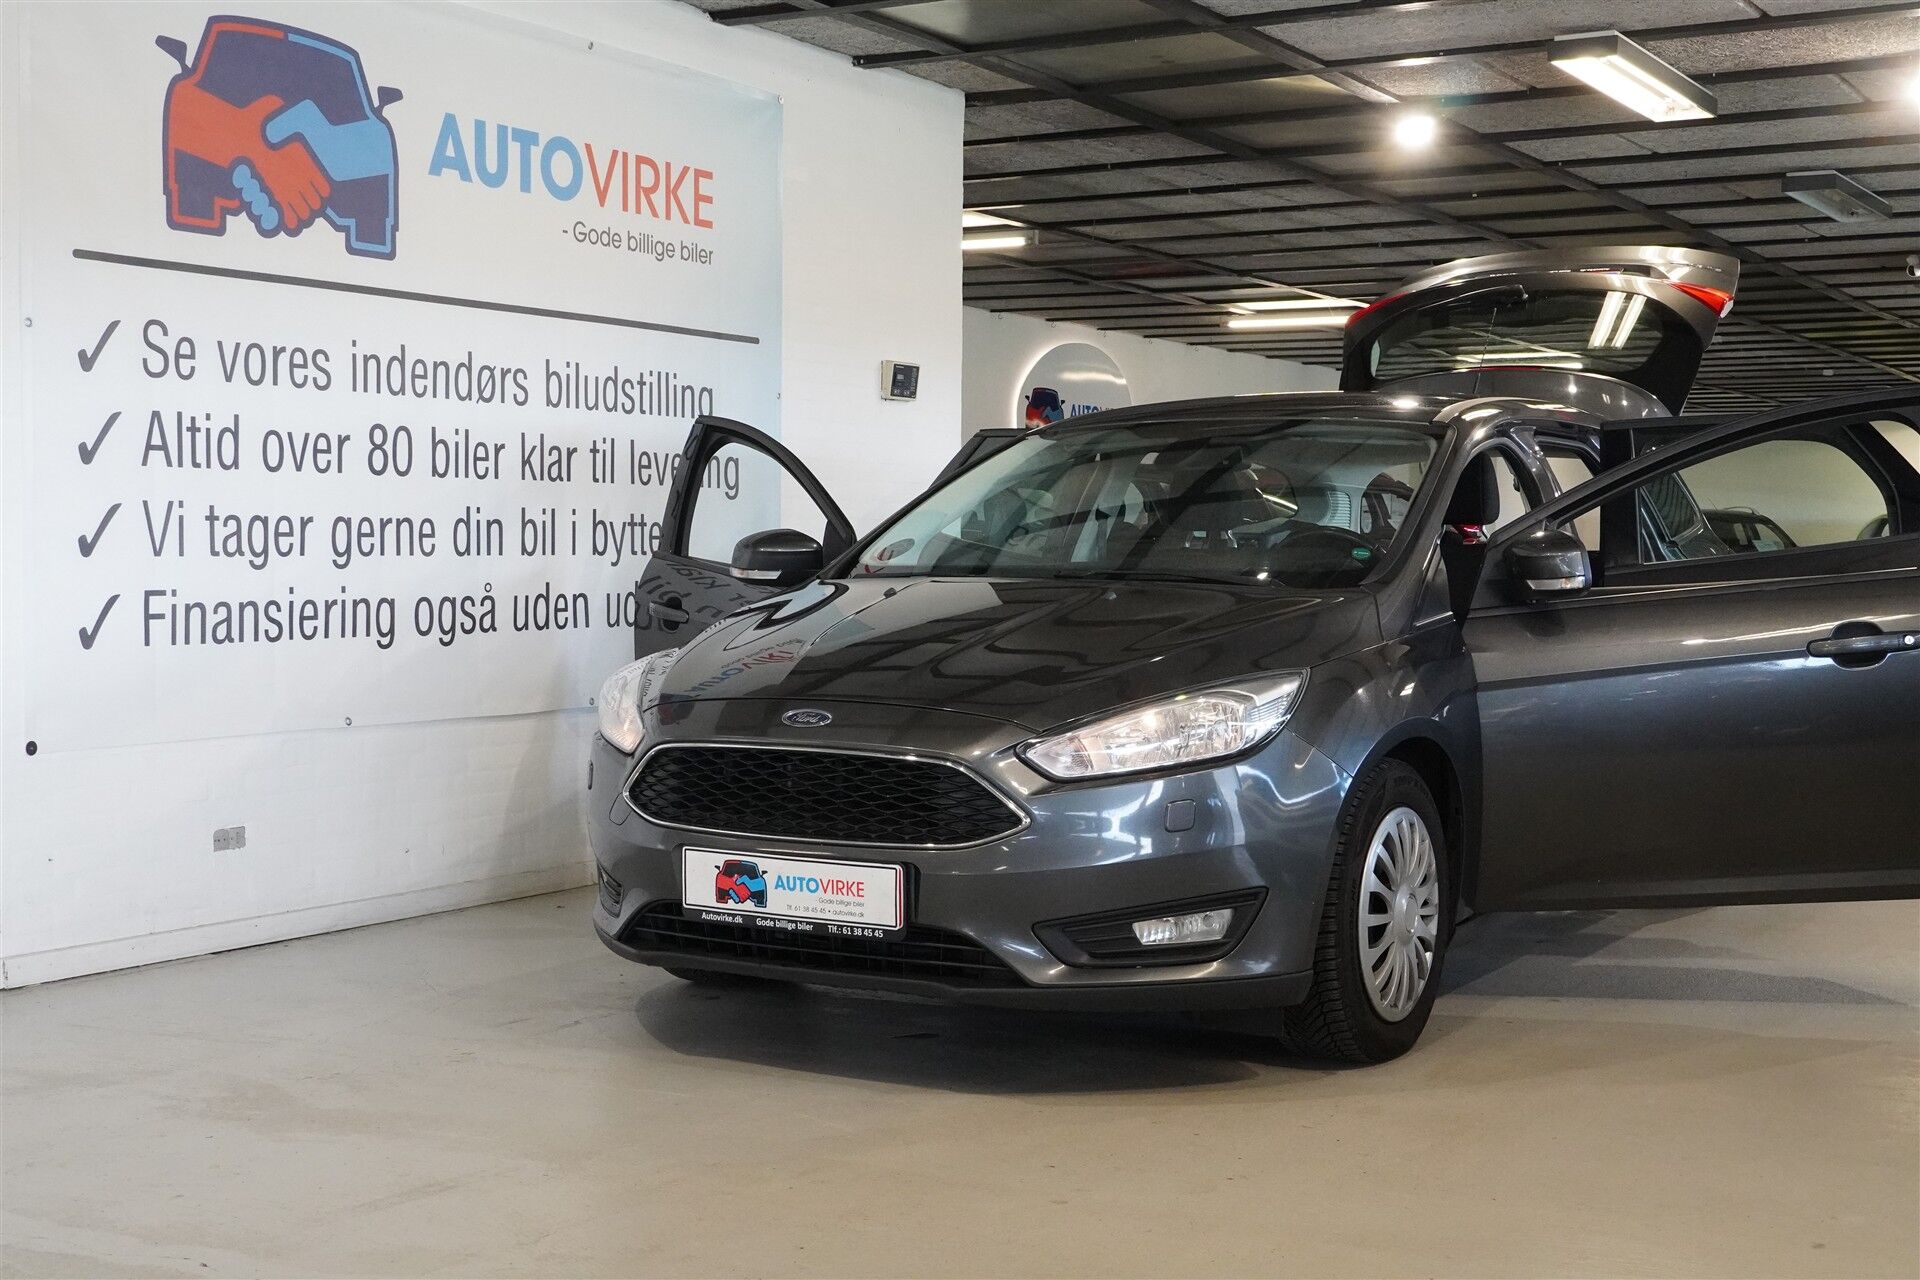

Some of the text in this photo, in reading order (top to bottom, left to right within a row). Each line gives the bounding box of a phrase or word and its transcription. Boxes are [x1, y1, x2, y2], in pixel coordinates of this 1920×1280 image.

[429, 113, 713, 230] AUTOVIRKE
[573, 221, 622, 249] Gode
[628, 231, 676, 262] billige
[681, 241, 714, 266] biler
[143, 319, 714, 419] Se vores indendørs biludstilling
[142, 411, 740, 500] Altid over 80 biler klar til leveng
[143, 500, 662, 570] Vi tager gerne din bil i bytte
[144, 586, 396, 650] Finansiering
[415, 582, 498, 648] også
[513, 580, 590, 633] uden
[774, 875, 865, 898] AUTOVIRKE
[818, 897, 835, 905] Gode
[835, 899, 852, 907] billige
[701, 911, 743, 924] Autovirke.dk
[756, 918, 774, 927] Gode
[775, 919, 796, 930] billige
[797, 922, 814, 931] biler
[842, 926, 852, 935] 61
[853, 927, 862, 936] 38
[863, 929, 873, 937] 45
[874, 930, 884, 938] 45
